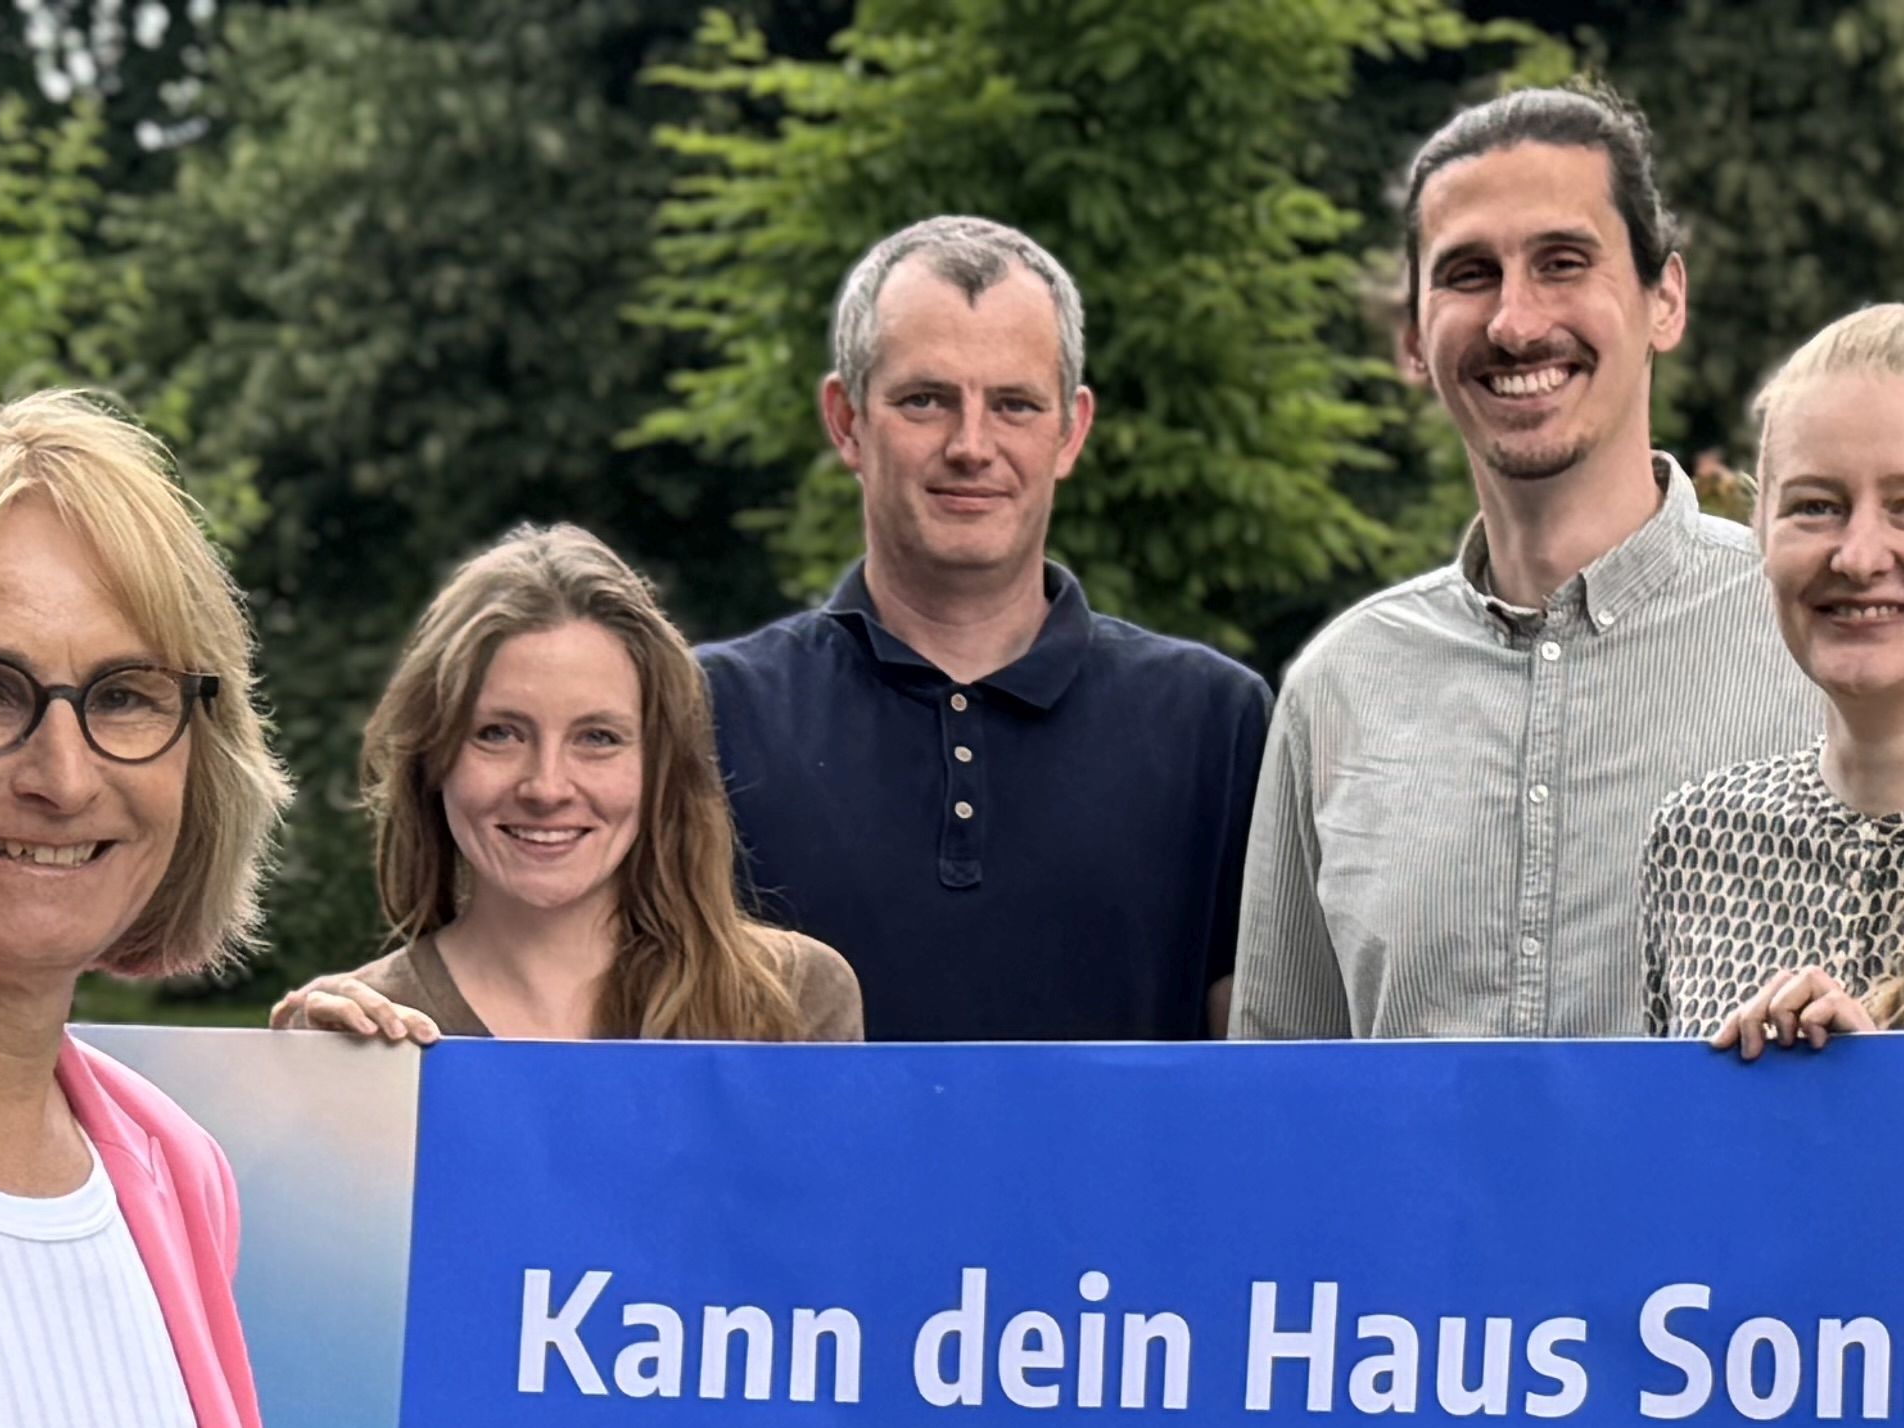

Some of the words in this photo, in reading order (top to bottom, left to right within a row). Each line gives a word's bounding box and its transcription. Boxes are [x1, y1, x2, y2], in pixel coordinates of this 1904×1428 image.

[519, 1269, 860, 1402] Kann
[914, 1268, 1190, 1409] dein
[1246, 1282, 1587, 1417] Haus
